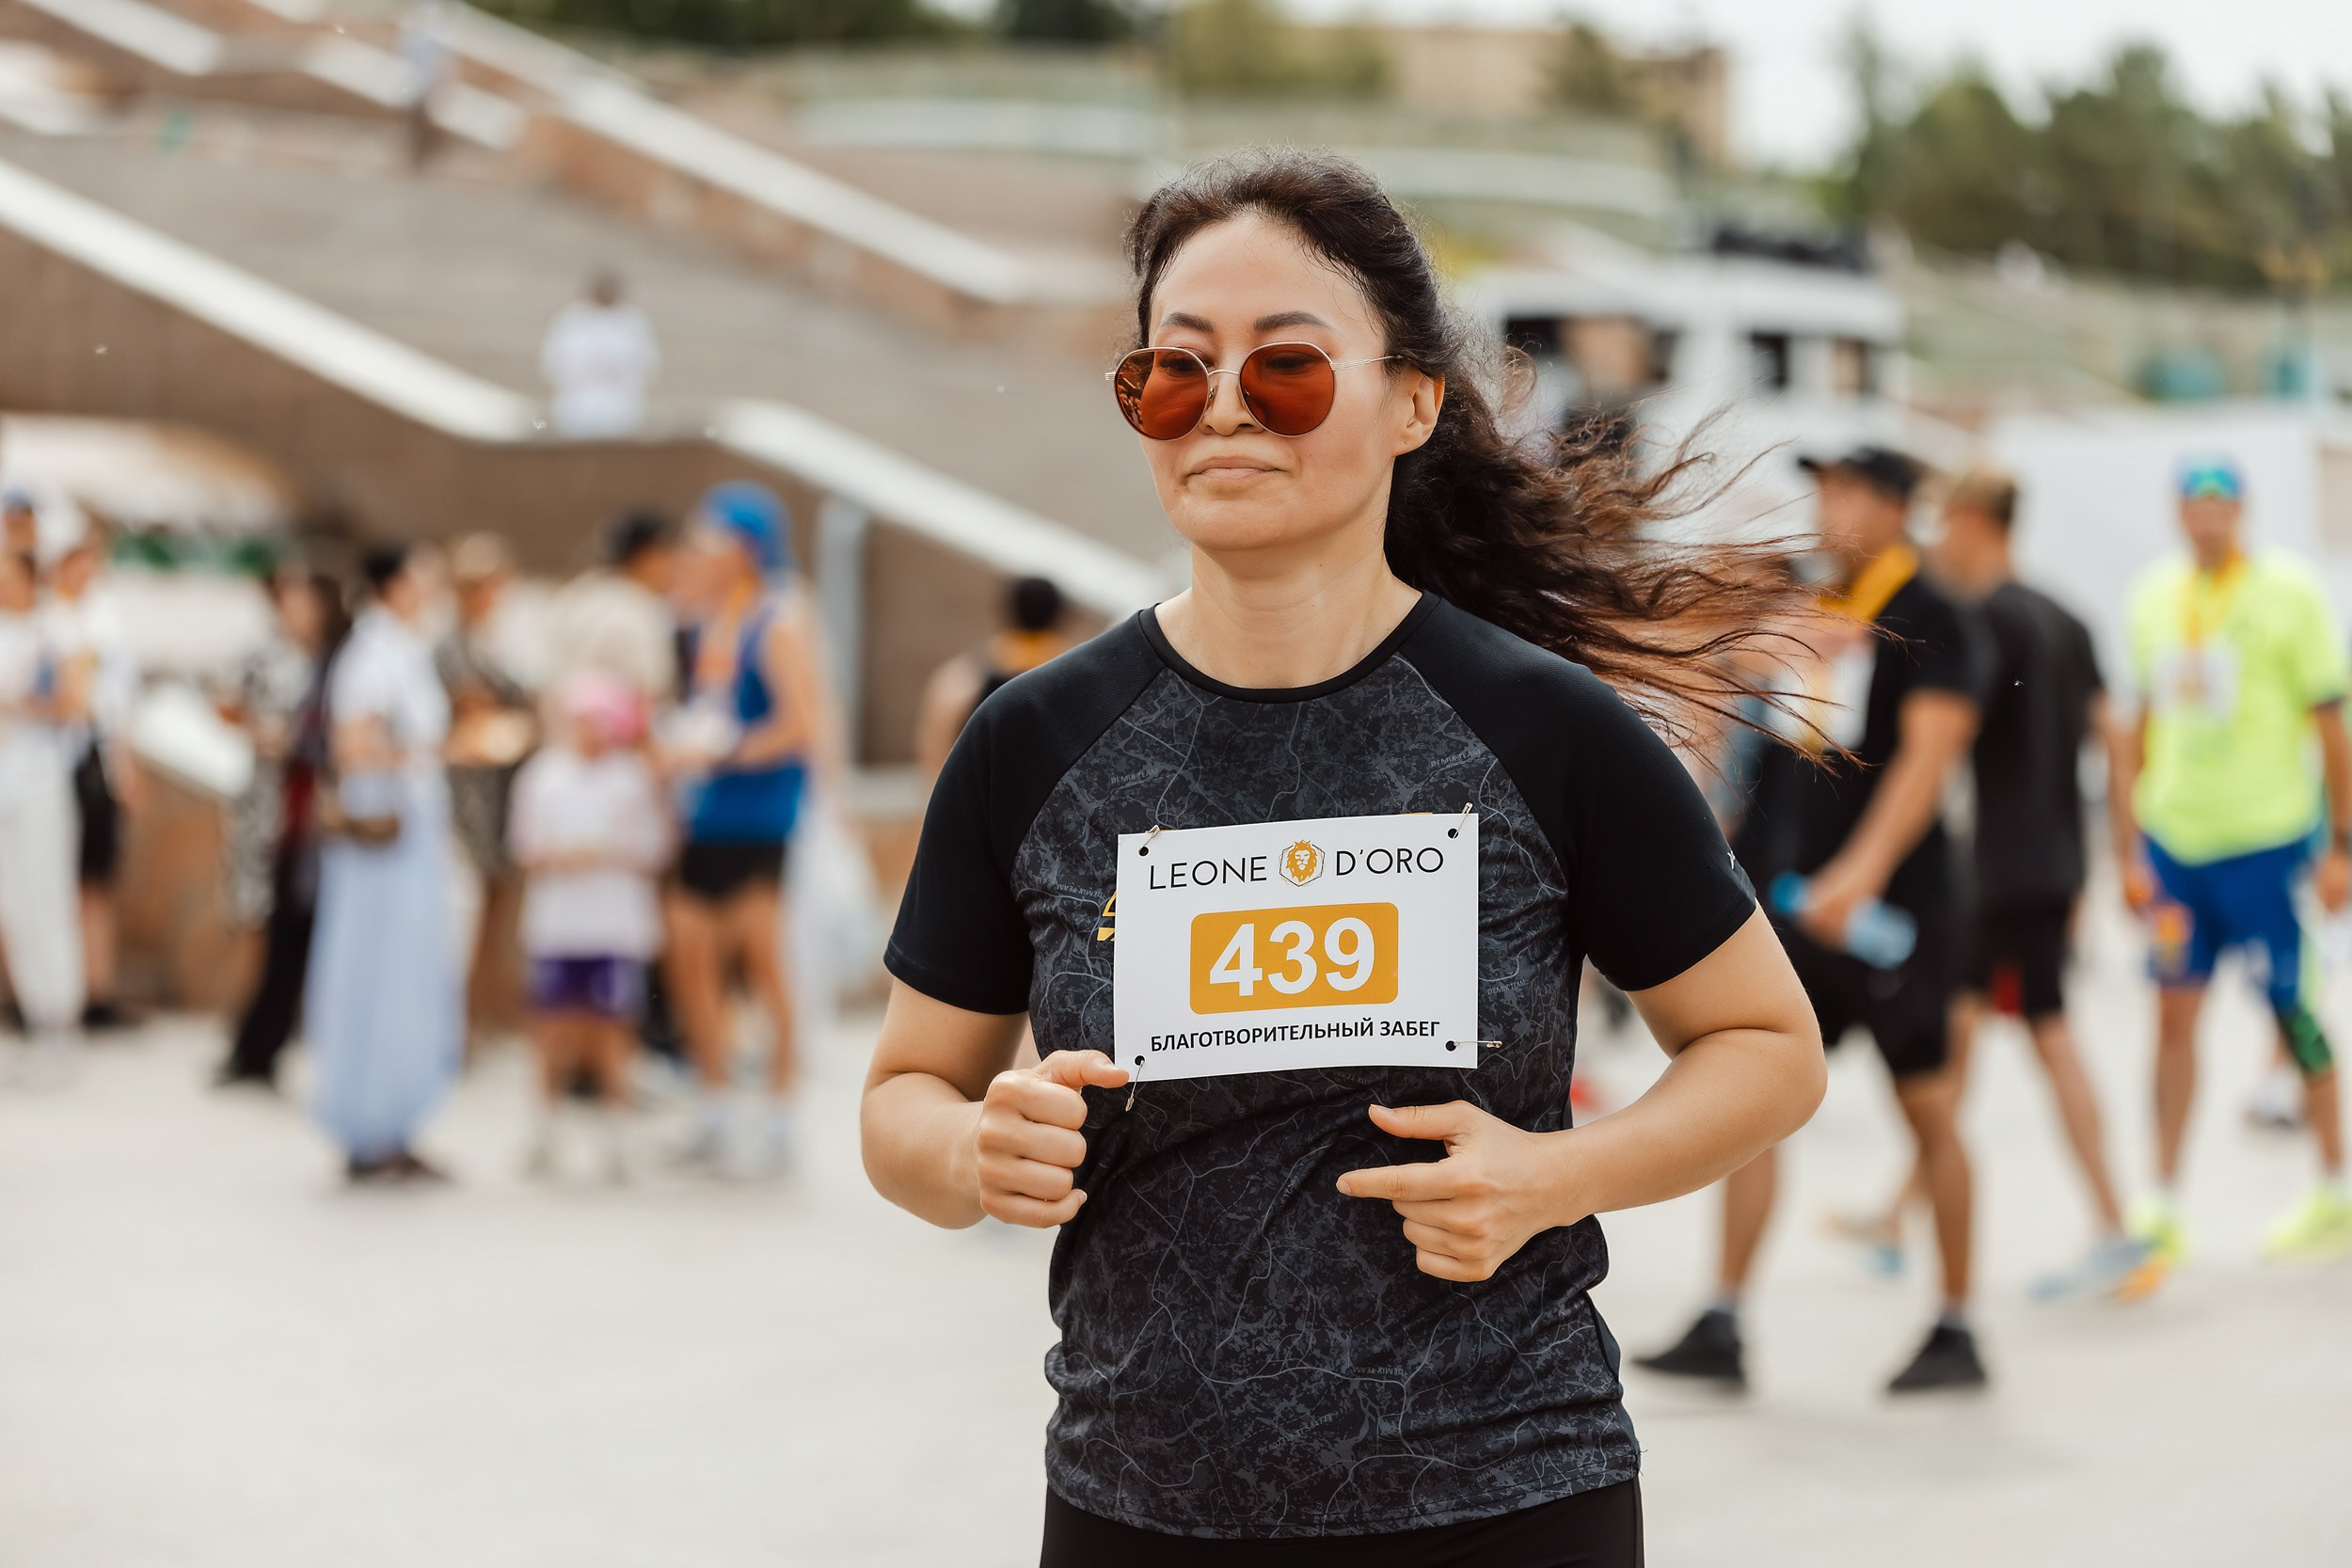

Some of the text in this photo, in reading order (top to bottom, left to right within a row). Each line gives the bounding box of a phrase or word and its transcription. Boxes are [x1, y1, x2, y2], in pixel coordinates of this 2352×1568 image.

[1149, 847, 1444, 890] LEONE D'ORO
[1209, 917, 1375, 997] 439
[1151, 1017, 1440, 1052] БЛАГОТВОРИТЕЛЬНЫЙ ЗАБЕГ
[1352, 1366, 1405, 1376] DEMIX TEAM
